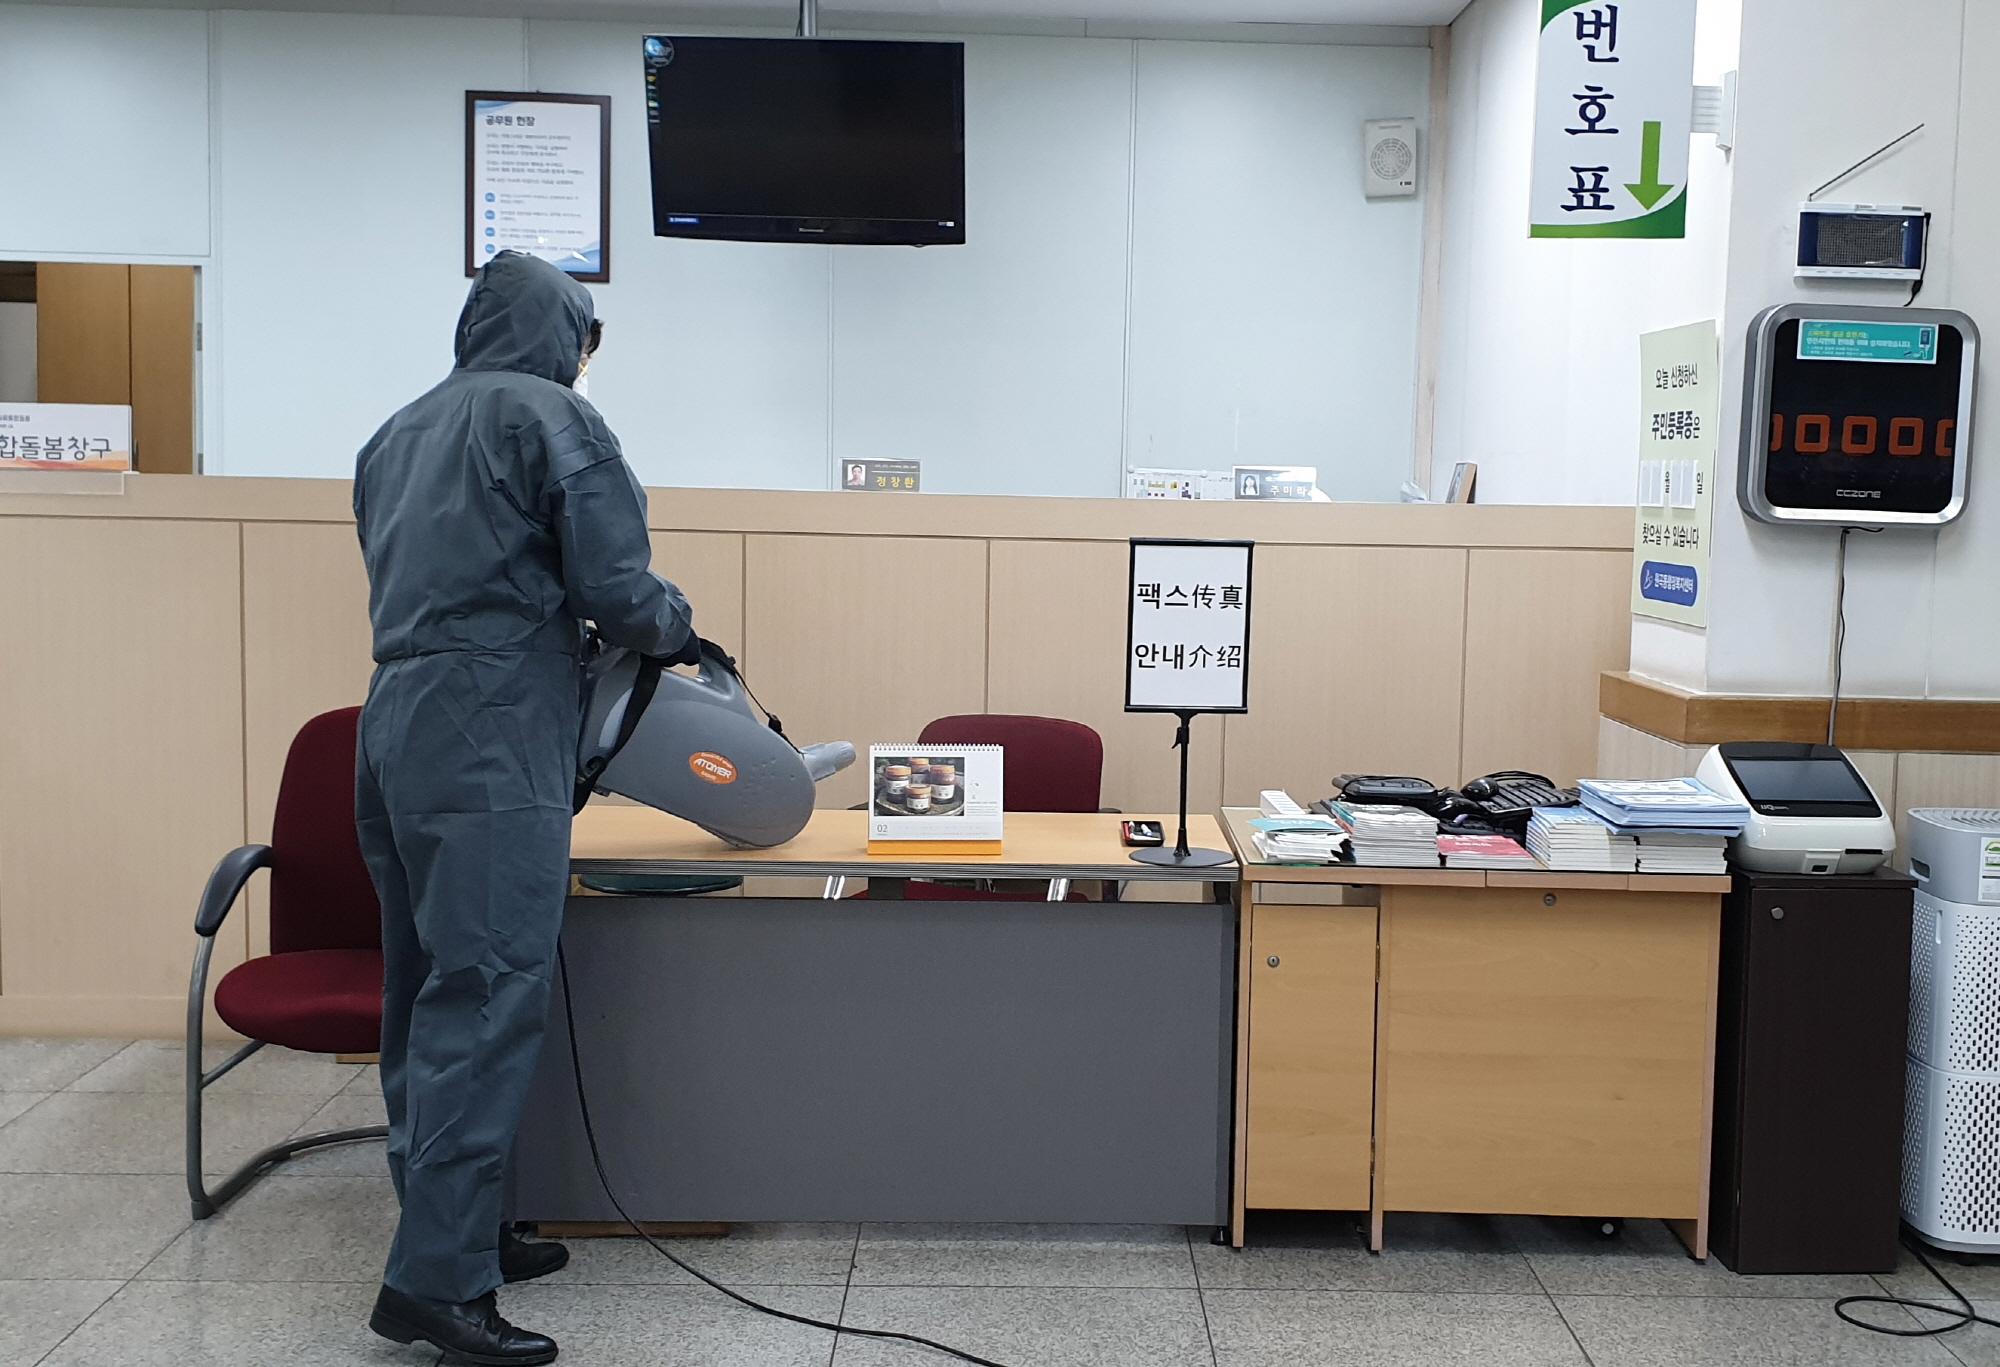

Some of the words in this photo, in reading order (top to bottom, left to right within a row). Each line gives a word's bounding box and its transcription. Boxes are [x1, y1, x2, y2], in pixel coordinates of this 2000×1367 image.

[1655, 367, 1669, 390] 오늘
[1671, 362, 1698, 388] 신청하신
[1651, 410, 1701, 442] 주민등록증은
[0, 434, 112, 461] 합돌봄창구
[1696, 471, 1704, 495] 일
[1836, 489, 1881, 499] CCZONE
[1642, 522, 1662, 546] 찾으실
[1663, 524, 1671, 547] 수
[1672, 525, 1700, 550] 있습니다
[877, 824, 888, 833] 02
